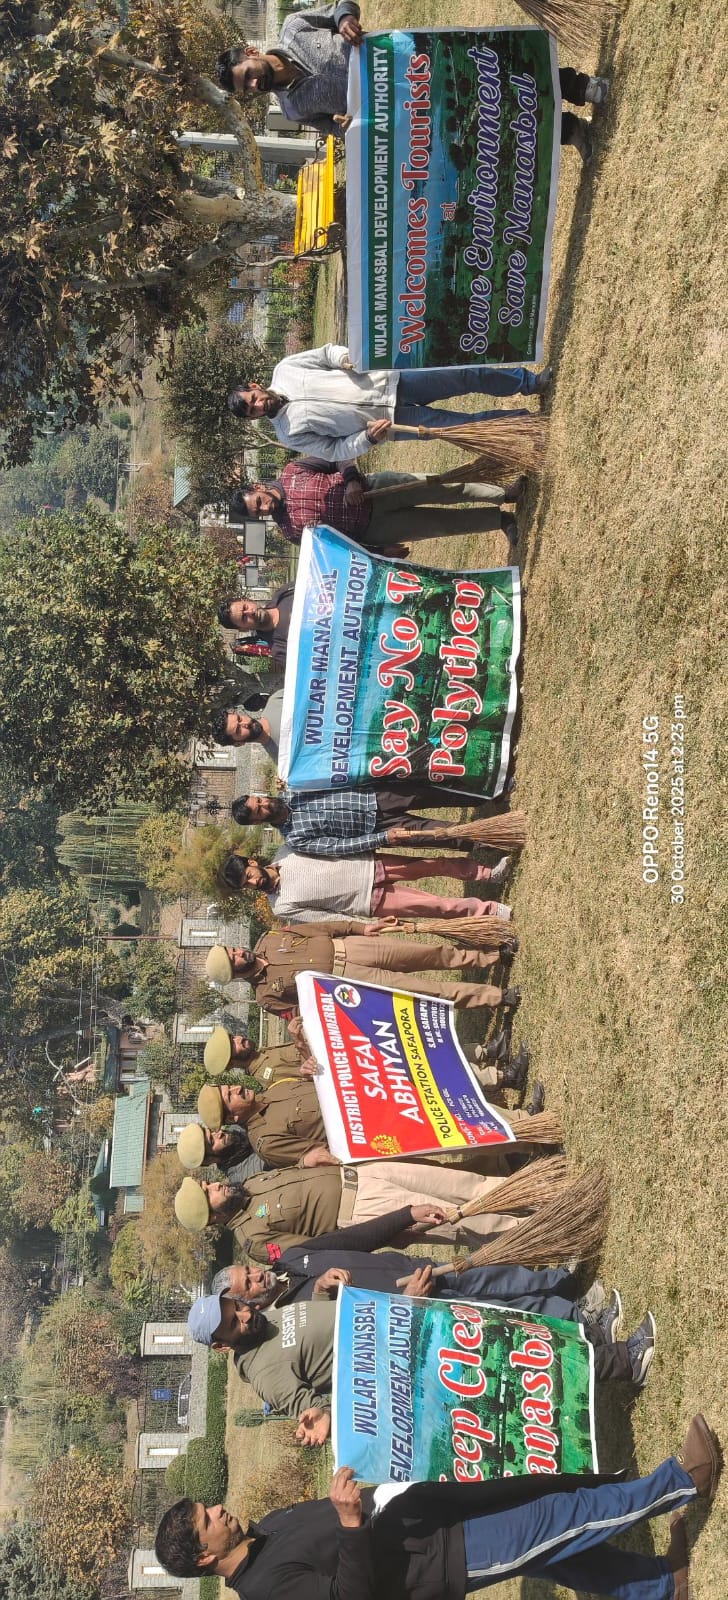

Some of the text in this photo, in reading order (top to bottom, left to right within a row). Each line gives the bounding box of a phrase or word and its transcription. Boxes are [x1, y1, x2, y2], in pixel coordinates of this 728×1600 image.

[373, 47, 389, 358] WULAR MANASBAL DEVELOPMENT AUTHORITY
[398, 53, 432, 353] Welcomes Tourists
[440, 202, 456, 220] at
[459, 47, 500, 354] Save Environment
[498, 72, 538, 326] Save Manasbal
[304, 568, 338, 745] WULAR MANASBAL
[376, 616, 422, 691] No
[428, 578, 484, 782] Polythen
[330, 646, 358, 783] DEVELOPMENT
[368, 700, 420, 778] Say
[320, 992, 367, 1144] DISTRICT POLICE GANDERBAL
[349, 1034, 388, 1099] SAFAI
[400, 1008, 422, 1060] SAFAPORA
[420, 999, 430, 1030] SAFAPO
[372, 1020, 424, 1124] ABHIYAN
[413, 1063, 438, 1105] STATION
[430, 1107, 452, 1138] POLICE
[282, 1302, 296, 1348] ESSENTIA
[353, 1300, 377, 1436] WULAR MANASBAL
[389, 1360, 413, 1482] EVELOPMENT
[439, 1408, 495, 1482] eep
[503, 1318, 558, 1477] anasbal
